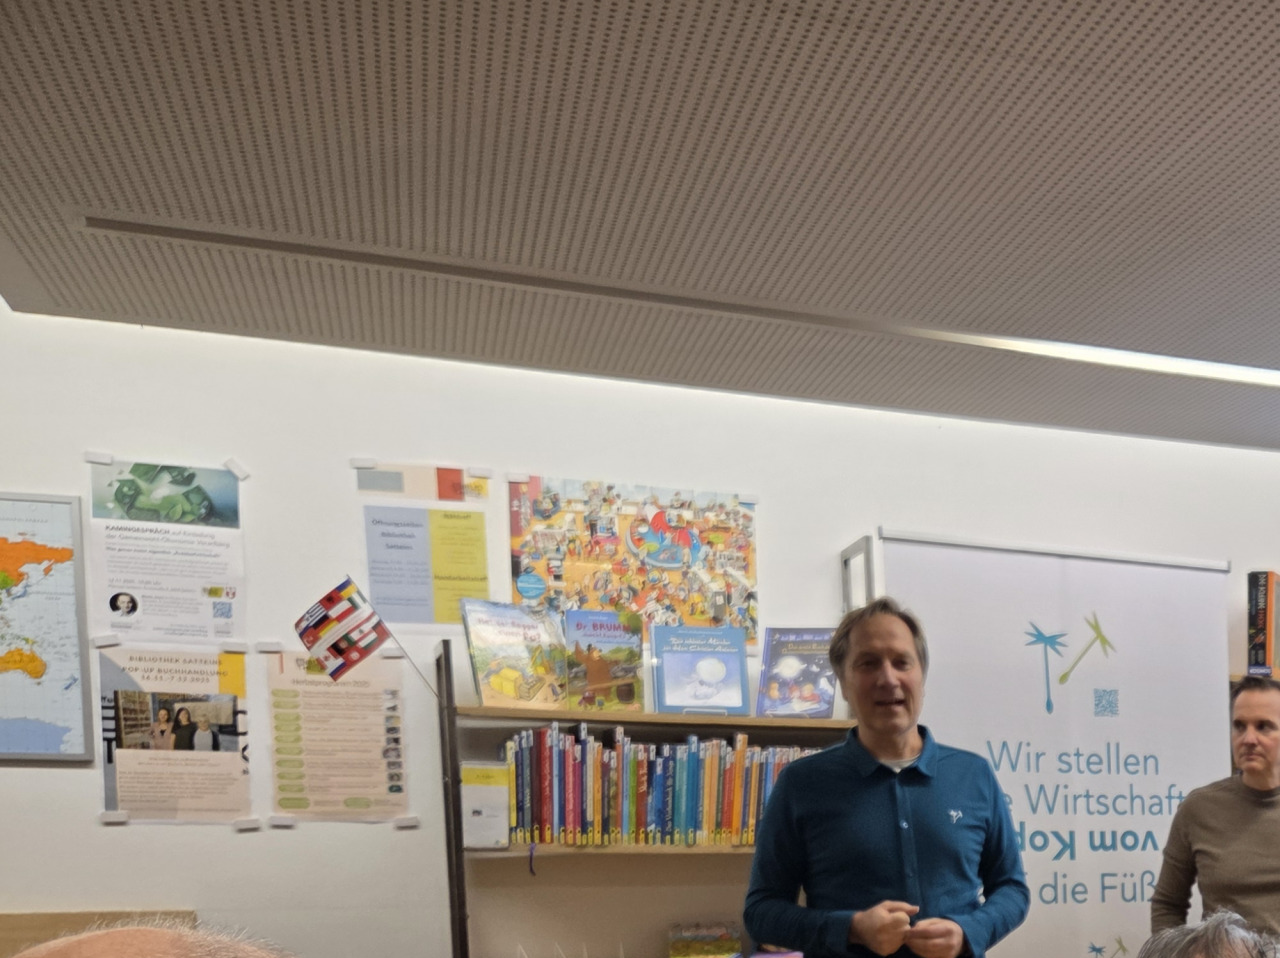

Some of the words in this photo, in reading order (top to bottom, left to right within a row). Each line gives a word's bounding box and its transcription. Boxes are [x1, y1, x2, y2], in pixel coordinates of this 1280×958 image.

[986, 740, 1046, 773] Wir
[1057, 741, 1159, 776] stellen
[1024, 783, 1186, 816] Wirtschaft
[1015, 821, 1077, 861] Kop
[1088, 830, 1160, 852] vom
[1038, 871, 1089, 905] die
[1100, 869, 1158, 904] Füß
